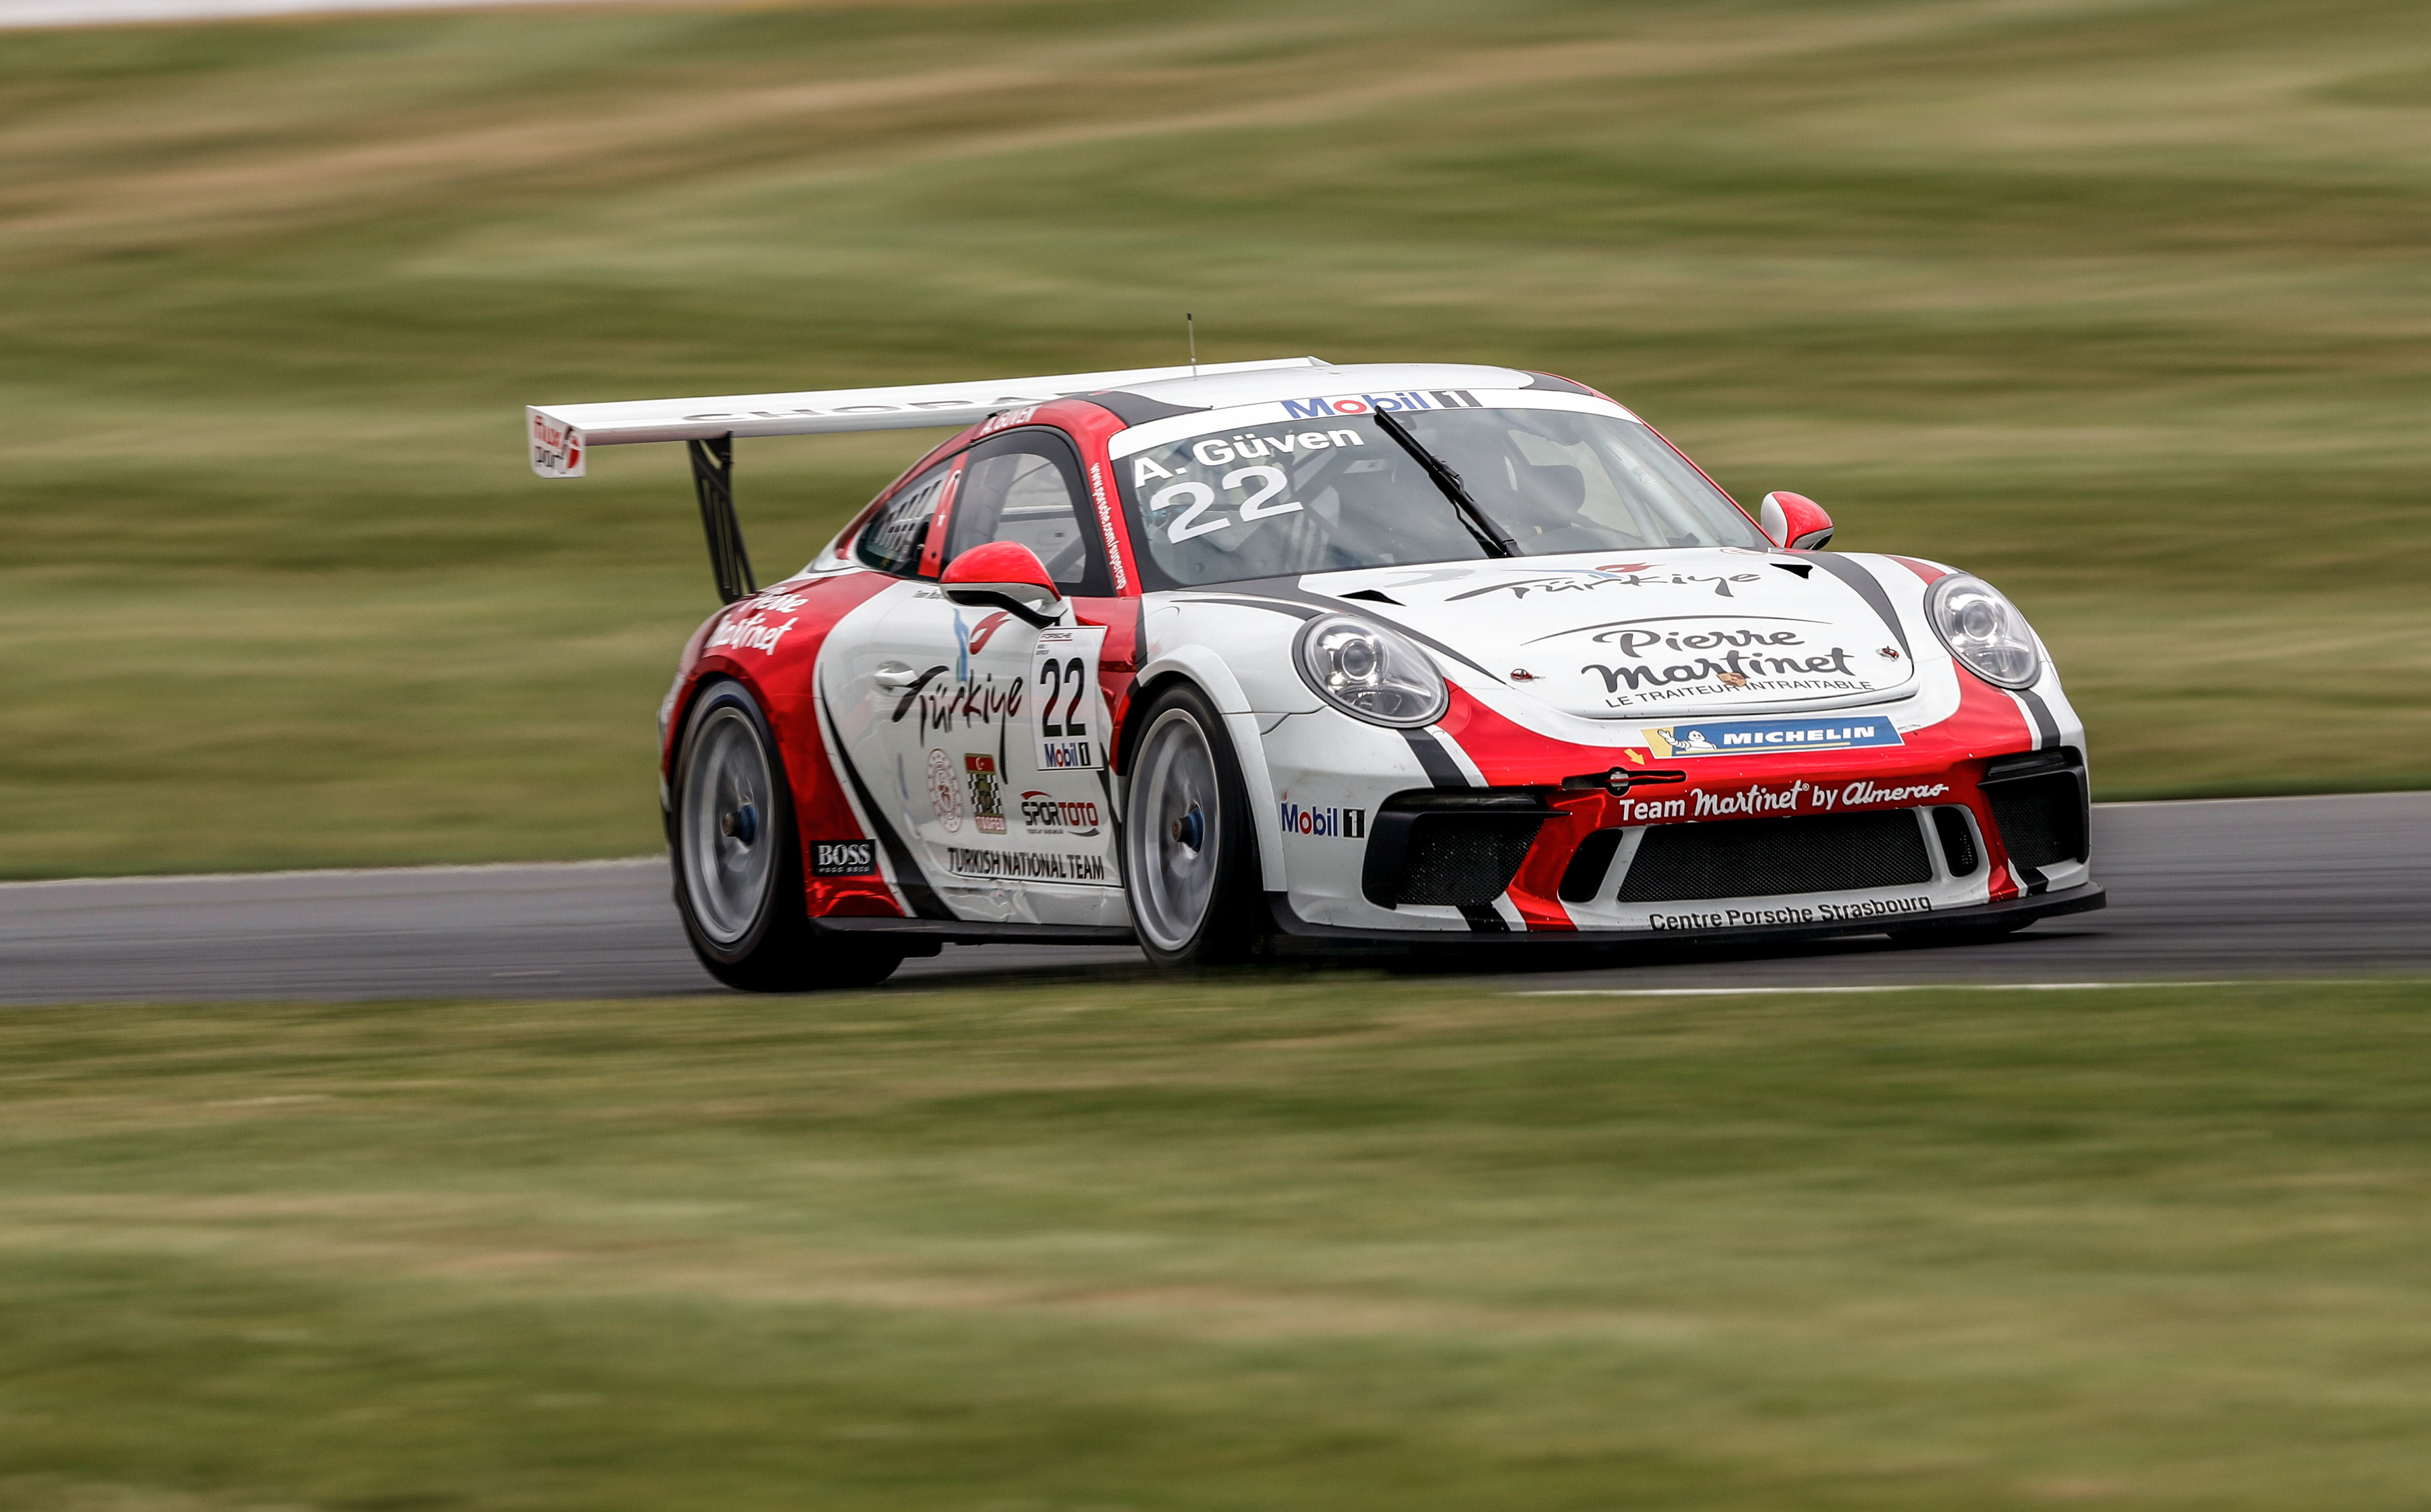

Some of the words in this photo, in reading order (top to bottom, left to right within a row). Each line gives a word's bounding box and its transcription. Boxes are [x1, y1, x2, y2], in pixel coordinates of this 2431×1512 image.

[683, 392, 1083, 420] CHOPA
[1281, 392, 1432, 419] Mobil
[1134, 456, 1187, 489] A.
[1192, 428, 1365, 466] Güven
[1150, 466, 1304, 544] 22
[1090, 462, 1127, 590] www.porsche.com/supercup
[1444, 572, 1761, 601] Türkiye
[1592, 630, 1805, 658] Pierre
[1040, 657, 1087, 737] 22
[1605, 696, 1633, 708] LE
[1635, 684, 1740, 701] TRAITEUR
[1745, 681, 1875, 691] INTRAITABLE
[892, 665, 1023, 785] Türkiye
[1723, 726, 1876, 745] MICHELIN
[1044, 742, 1079, 768] Mobil
[1281, 802, 1338, 837] Mobil
[1619, 796, 1686, 821] Team
[1812, 785, 1839, 811] by
[817, 843, 871, 865] BOSS
[947, 847, 1001, 875] TURKISH
[1002, 850, 1066, 878] NATIONAL
[1066, 854, 1105, 880] TEAM
[1649, 912, 1722, 931] Centre
[1726, 906, 1814, 926] Porsche
[1817, 895, 1932, 921] Strasbourg
